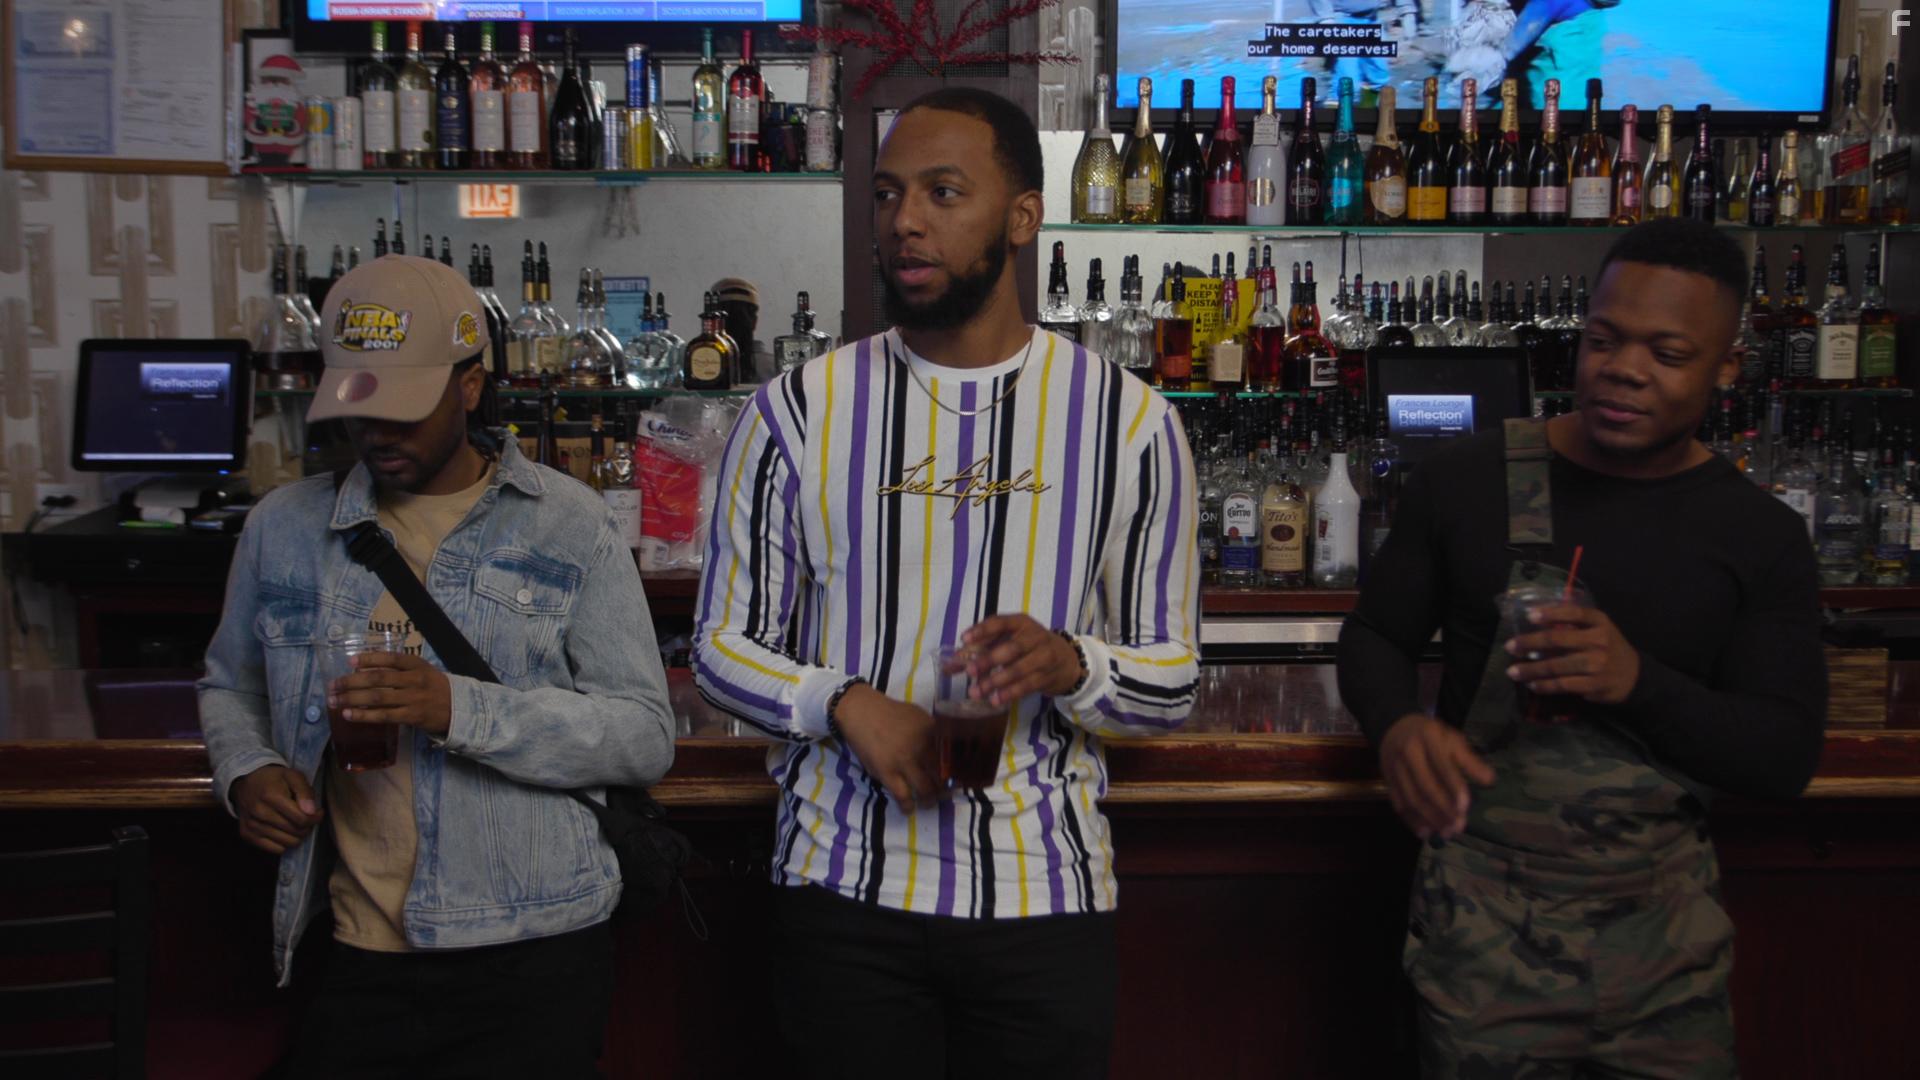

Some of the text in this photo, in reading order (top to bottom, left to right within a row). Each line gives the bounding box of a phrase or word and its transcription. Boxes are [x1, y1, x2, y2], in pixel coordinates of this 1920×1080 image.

[1265, 25, 1382, 37] The caretakers
[1248, 43, 1397, 55] our home deserves!
[1187, 291, 1212, 299] KEEP
[346, 309, 399, 328] NBA
[362, 339, 399, 350] 2001
[151, 377, 219, 389] Reflection
[1432, 399, 1465, 409] Lounge
[1399, 409, 1462, 420] Reflection
[1268, 511, 1298, 523] Tito's
